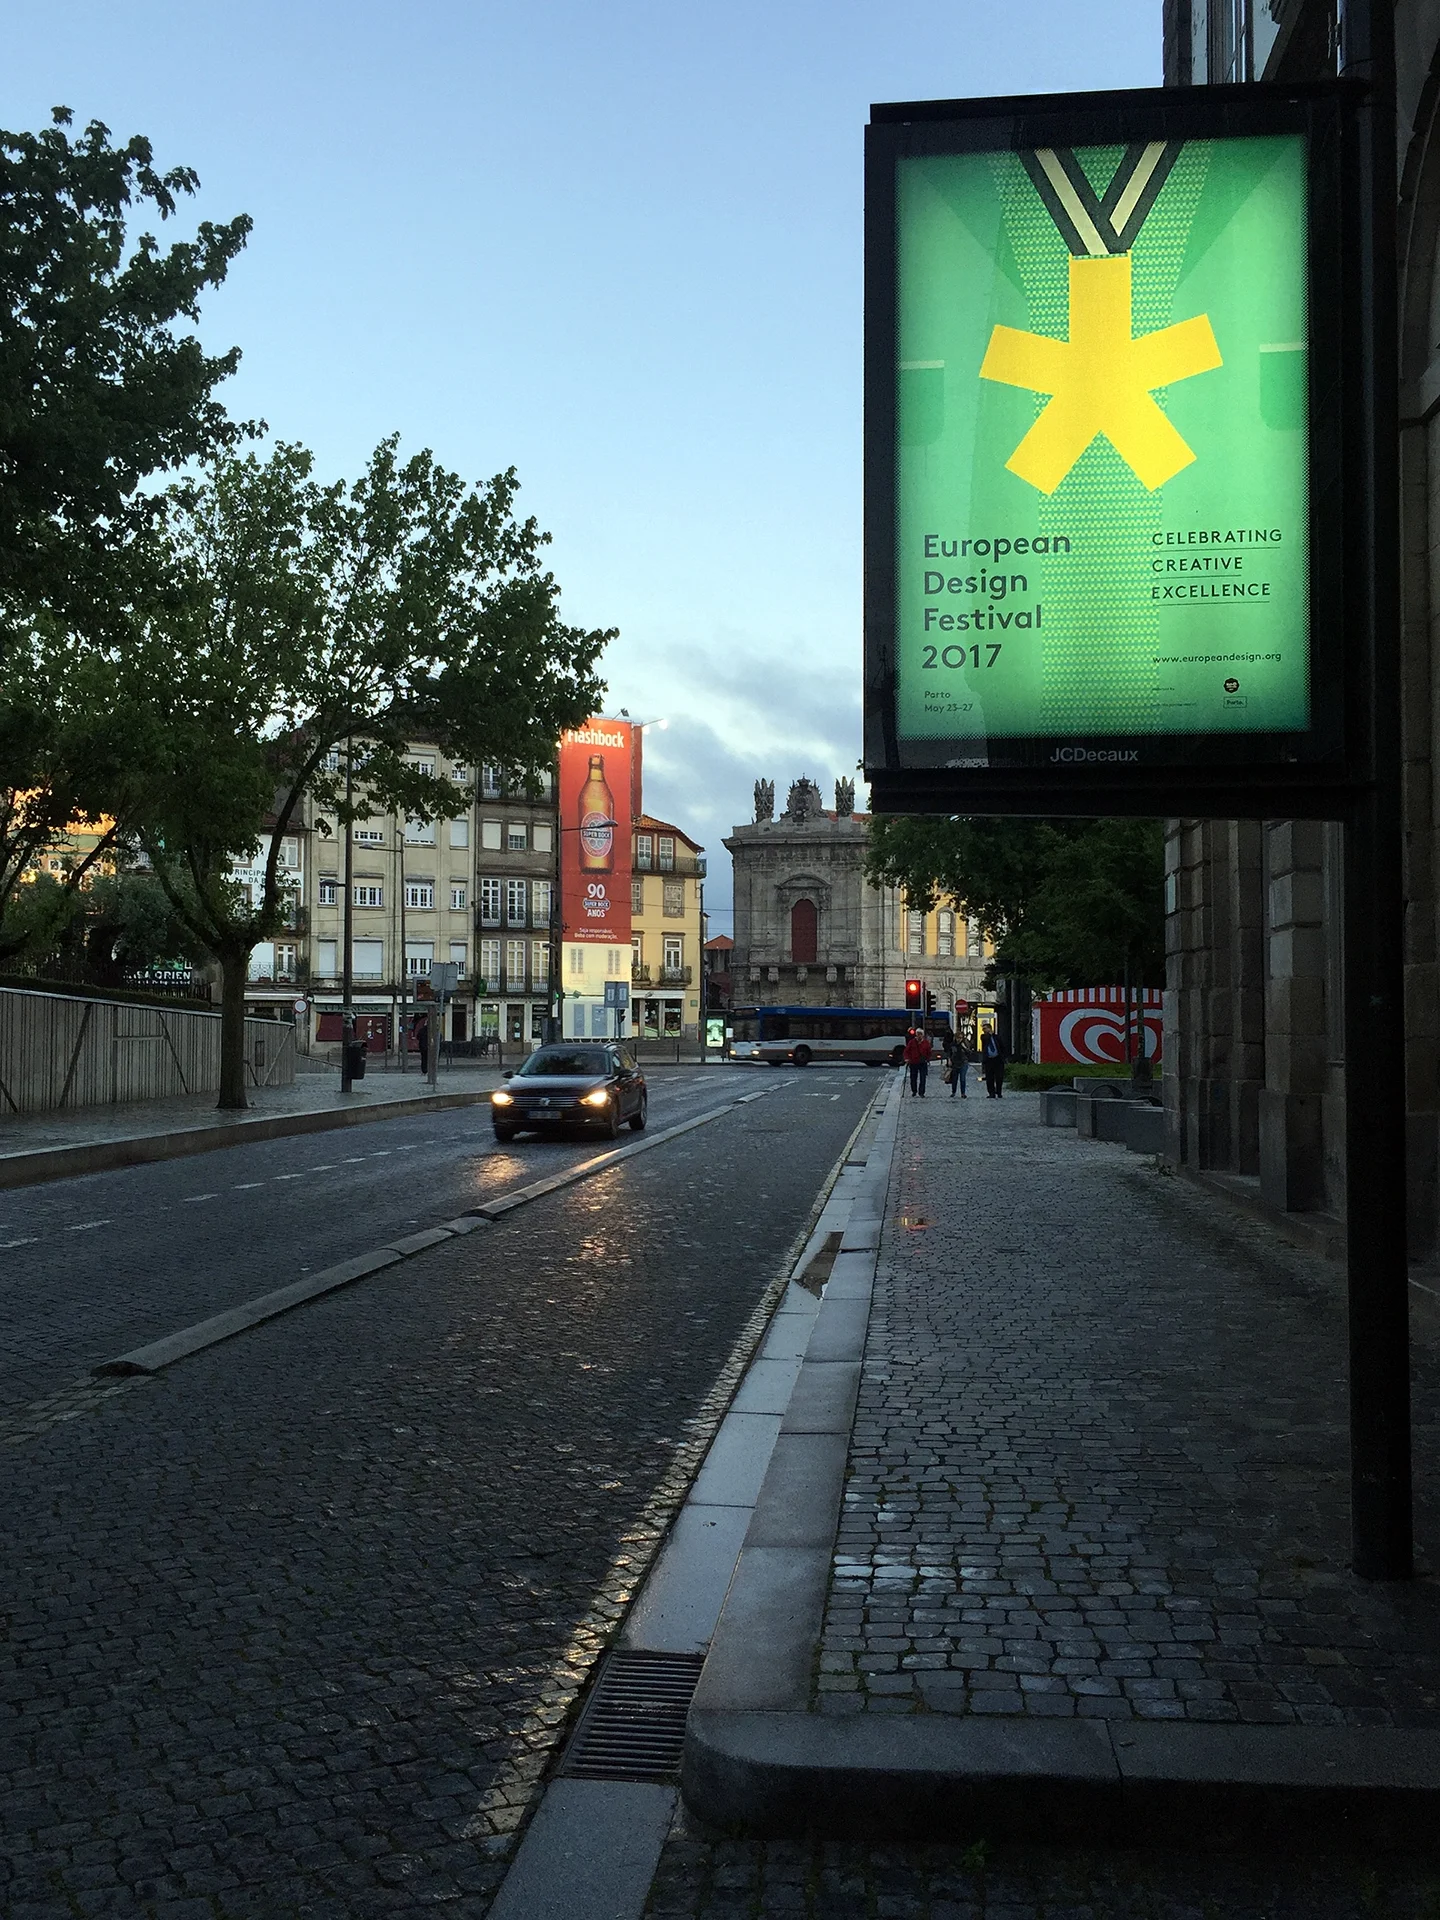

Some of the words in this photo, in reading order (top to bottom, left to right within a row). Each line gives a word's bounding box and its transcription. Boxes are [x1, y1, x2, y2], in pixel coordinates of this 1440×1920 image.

[1152, 529, 1282, 546] CELEBRATING
[924, 534, 1070, 563] European
[1152, 556, 1243, 573] CREATIVE
[924, 568, 1028, 601] Design
[1152, 583, 1271, 599] EXCELLENCE
[924, 604, 1042, 631] Festival
[922, 644, 1002, 669] 2017
[1153, 652, 1282, 664] www.europeandesign.org
[924, 690, 951, 699] Porto
[924, 704, 945, 714] May
[567, 728, 625, 749] Flashbock
[1049, 747, 1139, 762] JCDecaux
[583, 830, 598, 838] SUPER
[587, 883, 606, 899] 90
[587, 909, 606, 918] ANOS
